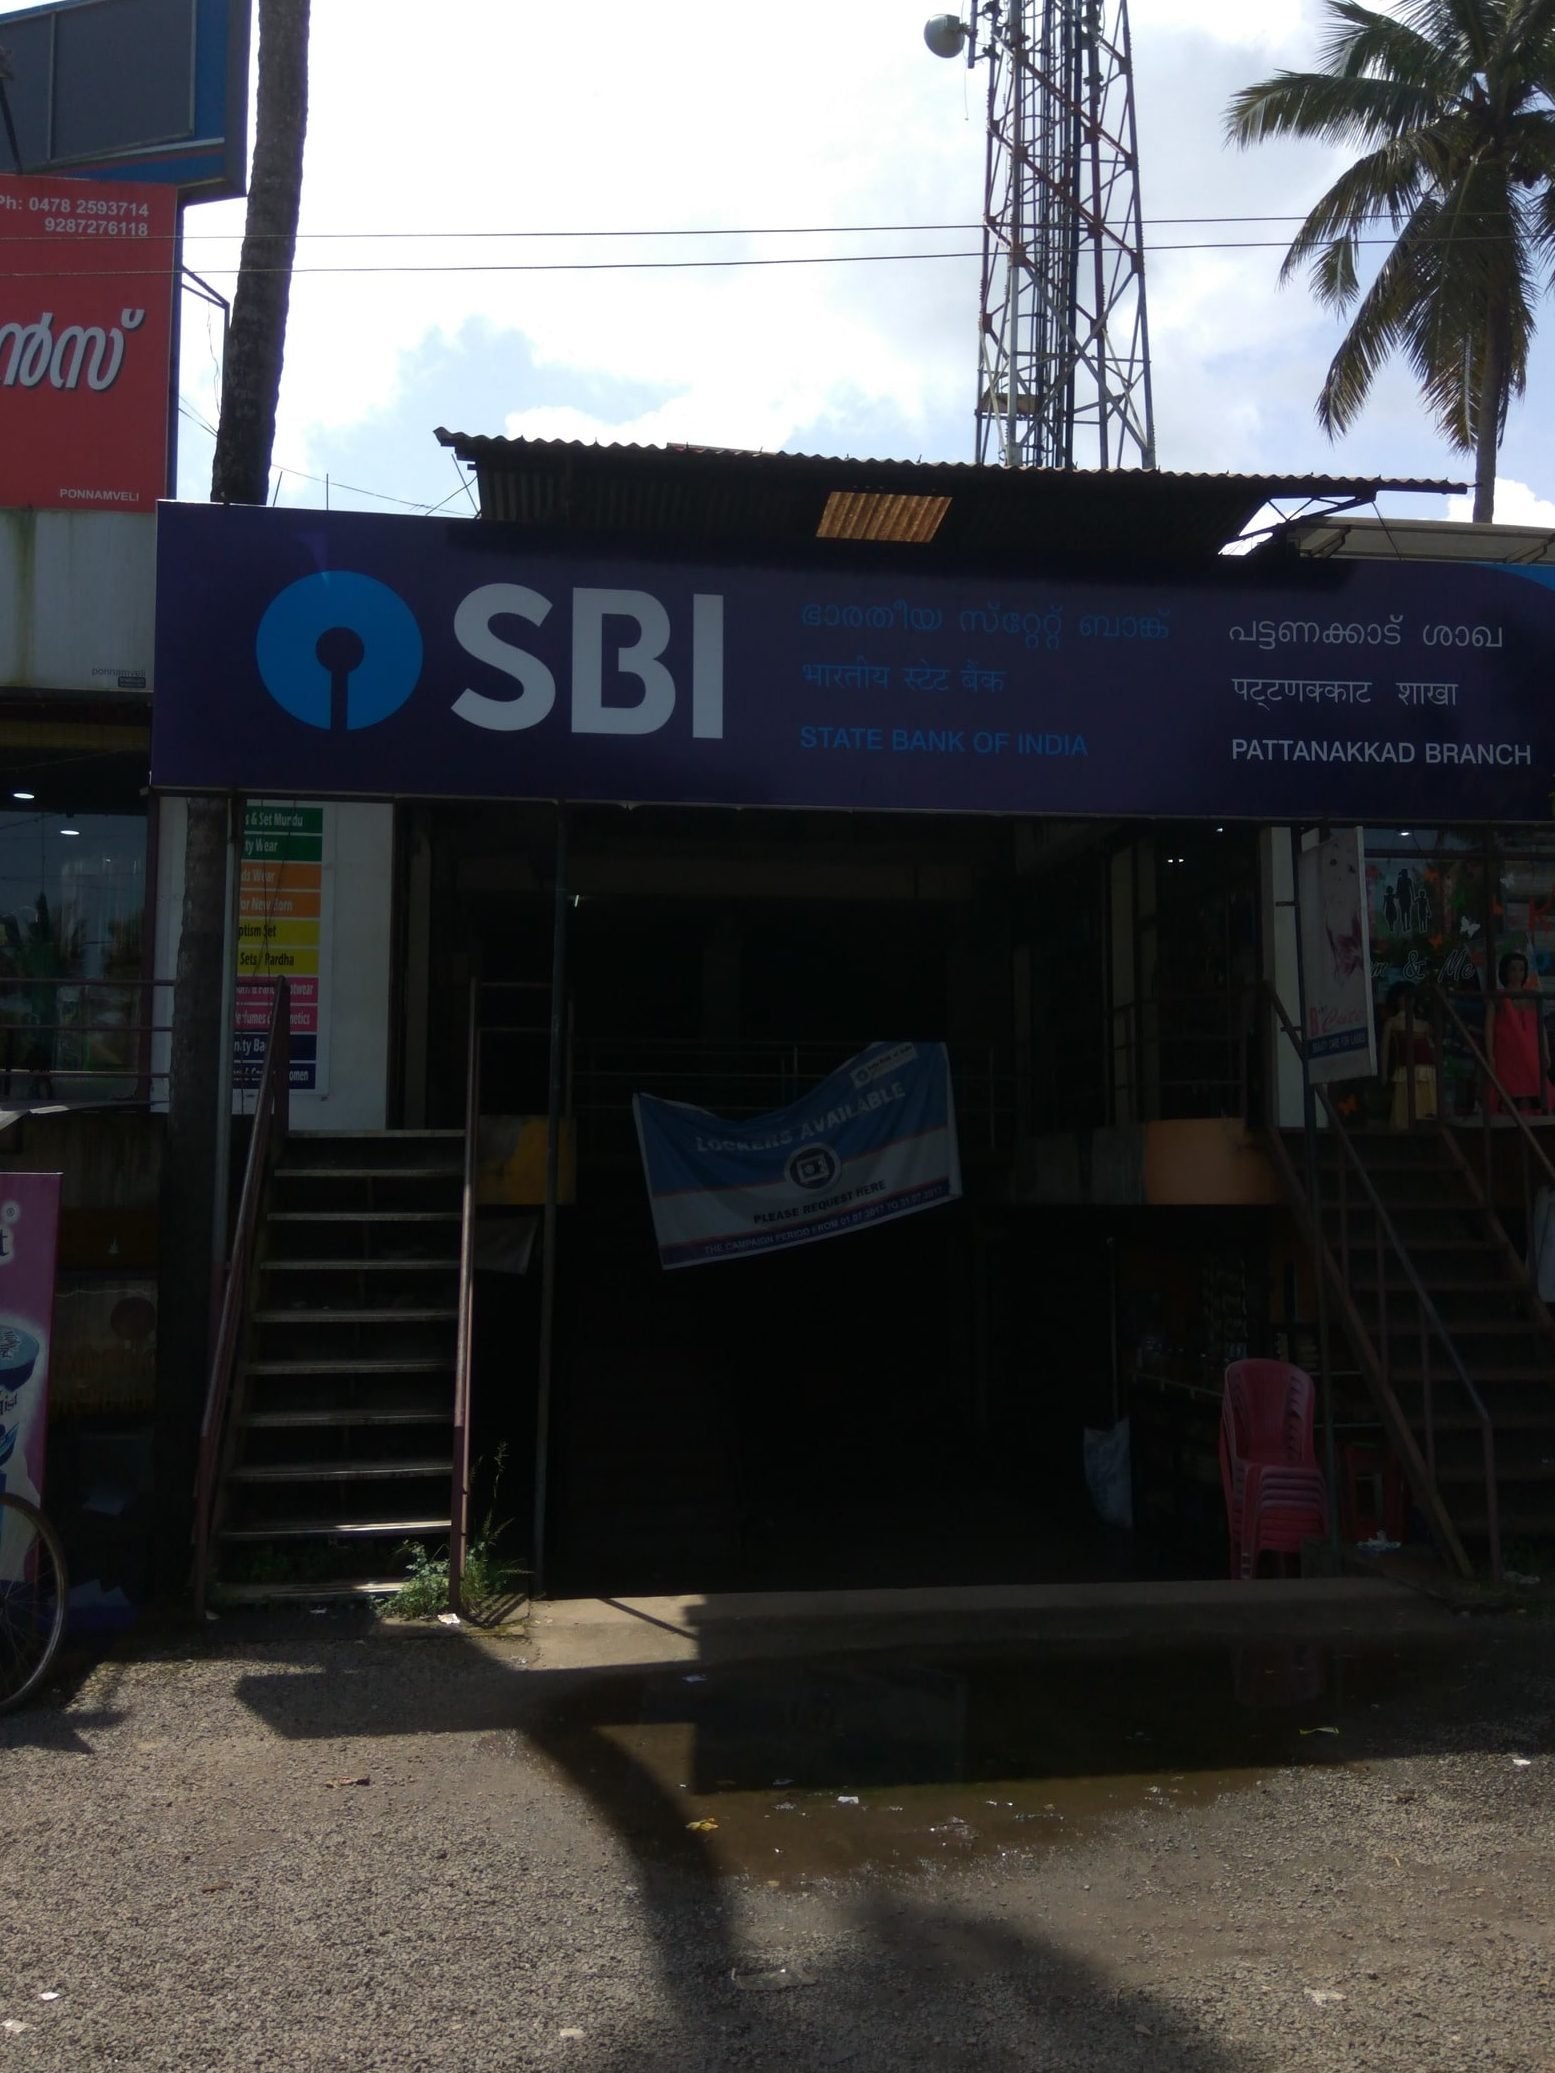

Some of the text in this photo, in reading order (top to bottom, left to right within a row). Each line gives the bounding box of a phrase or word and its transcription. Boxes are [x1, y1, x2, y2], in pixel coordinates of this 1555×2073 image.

[29, 196, 71, 213] 0478
[76, 199, 150, 218] 2593714
[43, 217, 149, 236] 9287276118
[59, 488, 140, 502] PONNAMVELI
[801, 600, 944, 632] ഭാരതീയ
[1229, 614, 1504, 650] പട്ടണക്കാട് ശാഖ
[450, 582, 725, 740] SBI
[801, 655, 1008, 693] भारतीय स्टेट बैंक
[1395, 682, 1459, 706] शाखा
[800, 726, 1089, 757] STATE BANK OF INDIA
[1231, 738, 1532, 766] PATTANAKKAD BRANCH
[259, 811, 273, 827] Set
[255, 838, 279, 853] Wear
[695, 1083, 905, 1153] LOCKERS AVAILABLE
[753, 1179, 888, 1225] PLEASE REQUEST HERE
